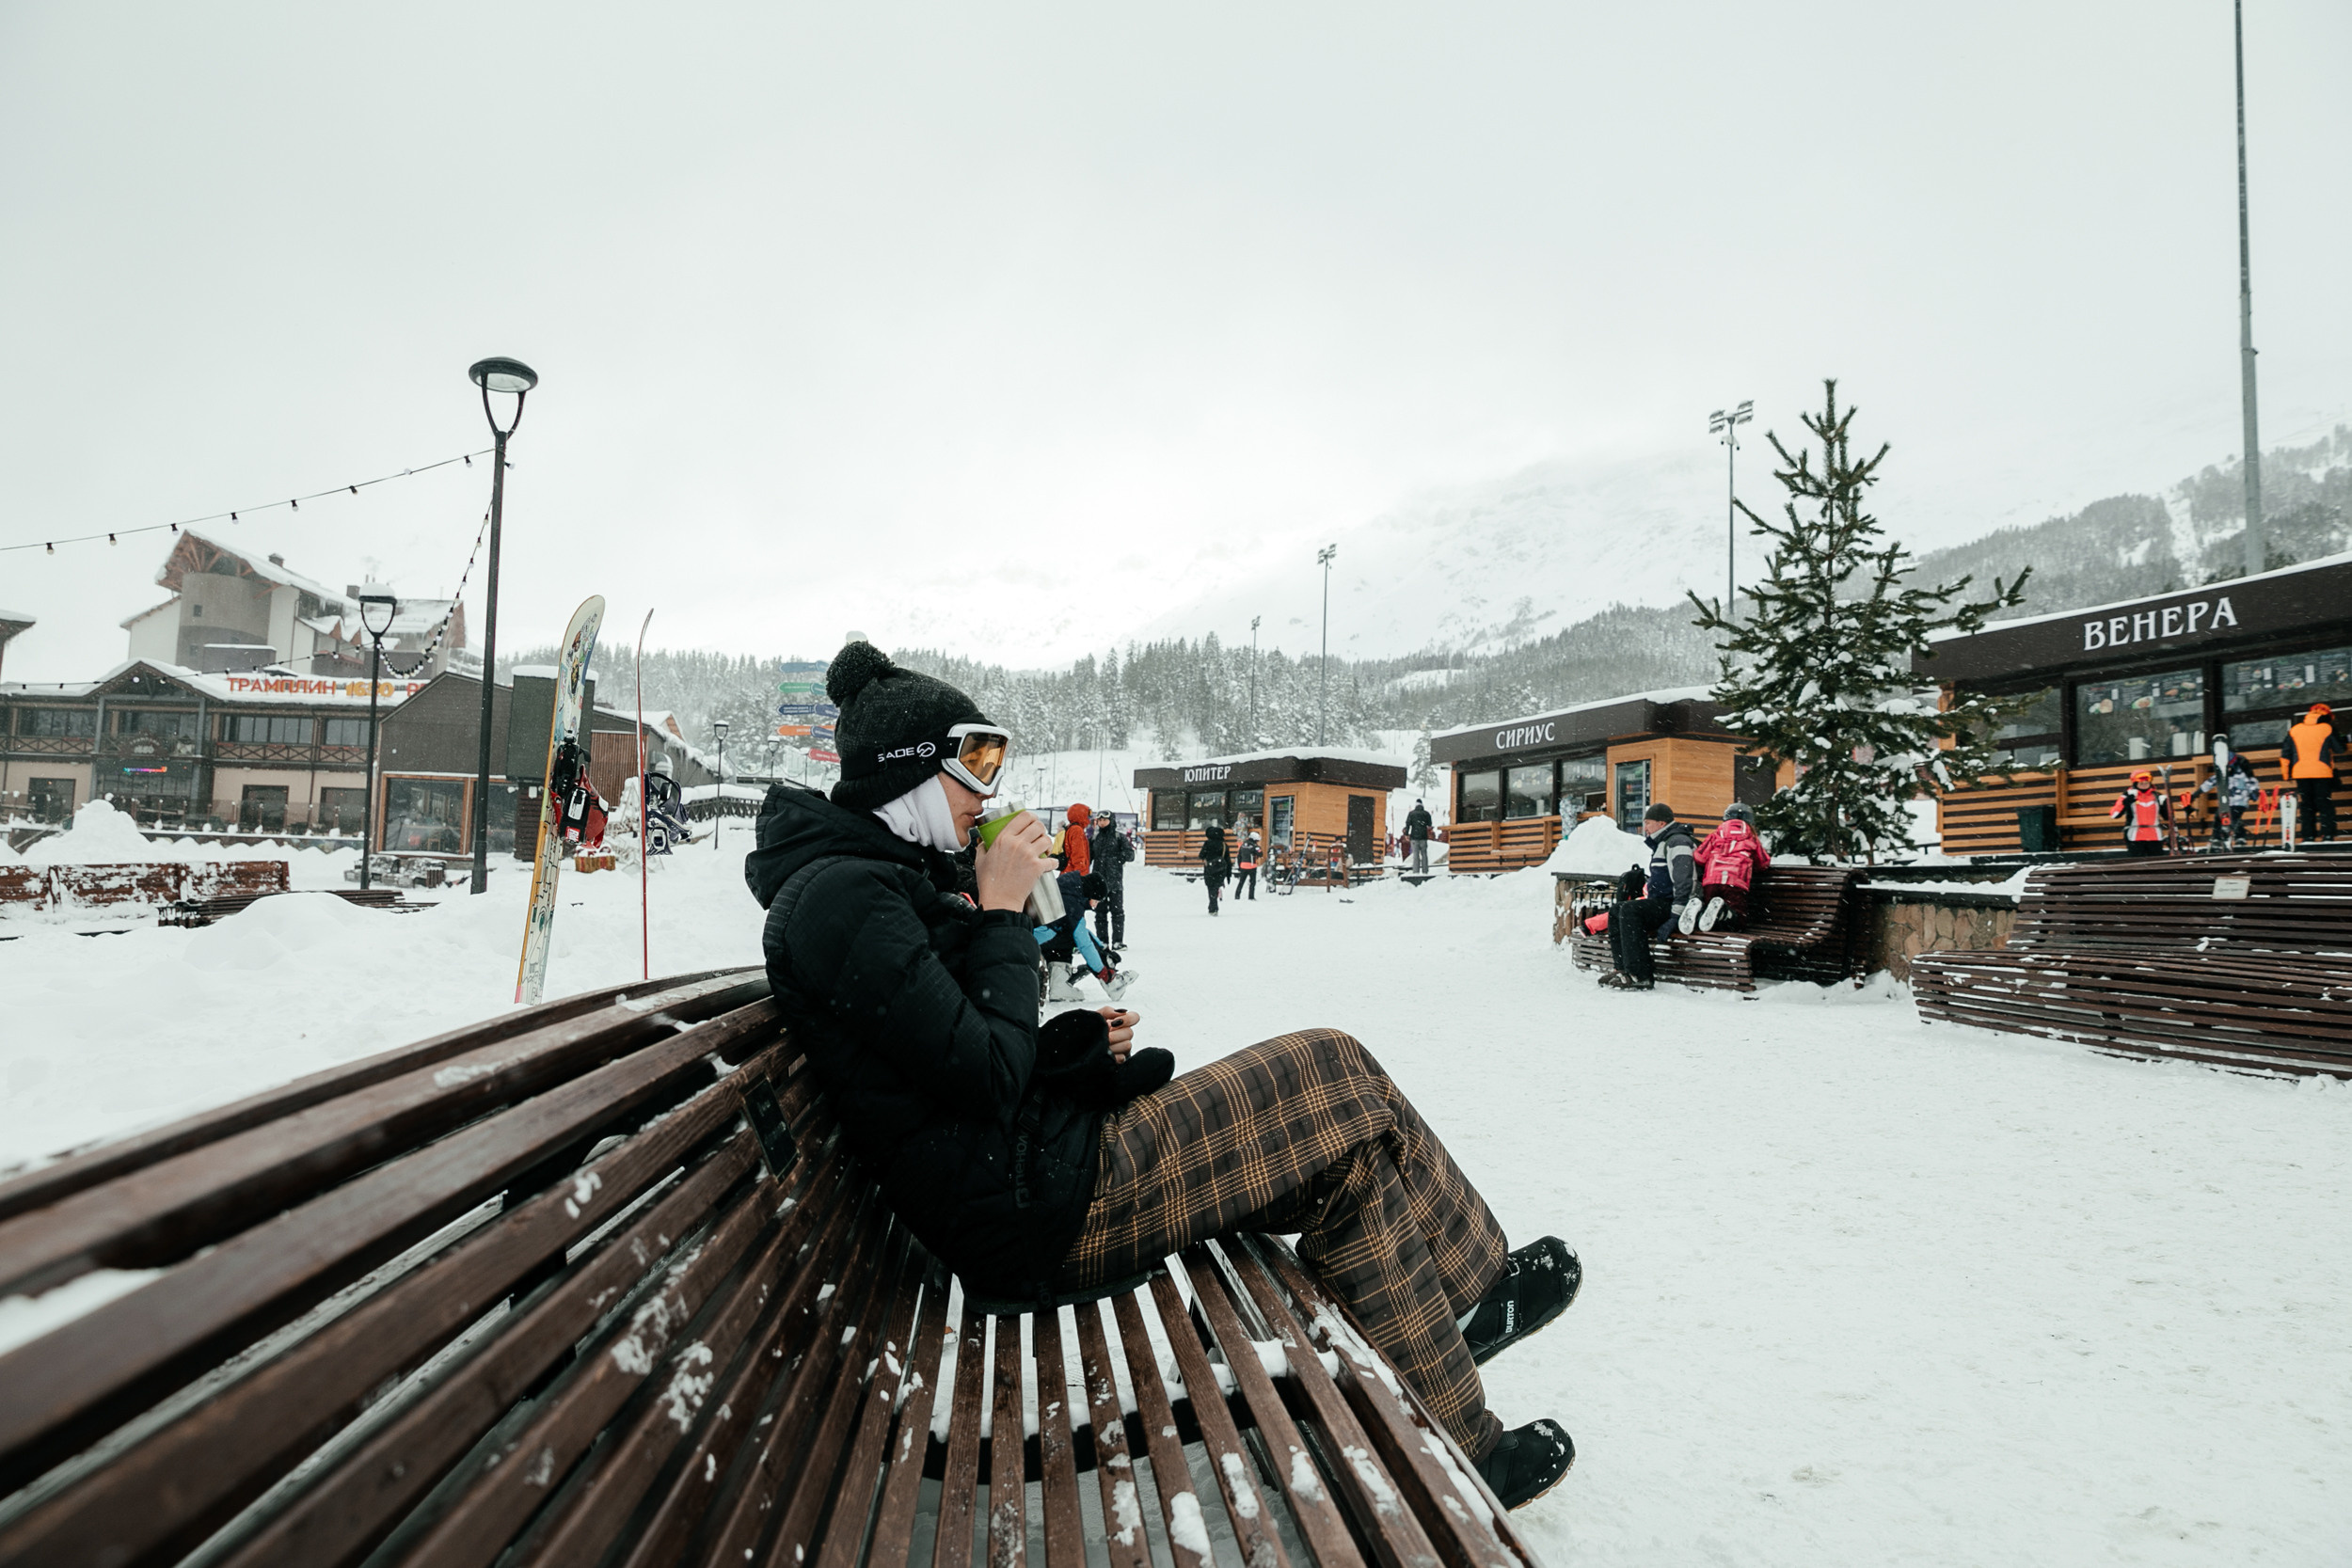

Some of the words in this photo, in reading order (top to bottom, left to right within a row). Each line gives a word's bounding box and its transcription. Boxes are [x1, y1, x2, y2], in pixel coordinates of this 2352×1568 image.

[2083, 596, 2238, 651] ВЕНЕРА
[227, 677, 336, 695] ТРАМПЛИН
[1495, 721, 1555, 750] СИРИУС
[1184, 766, 1232, 783] ЮПИТЕР
[1505, 1300, 1515, 1334] BURTON
